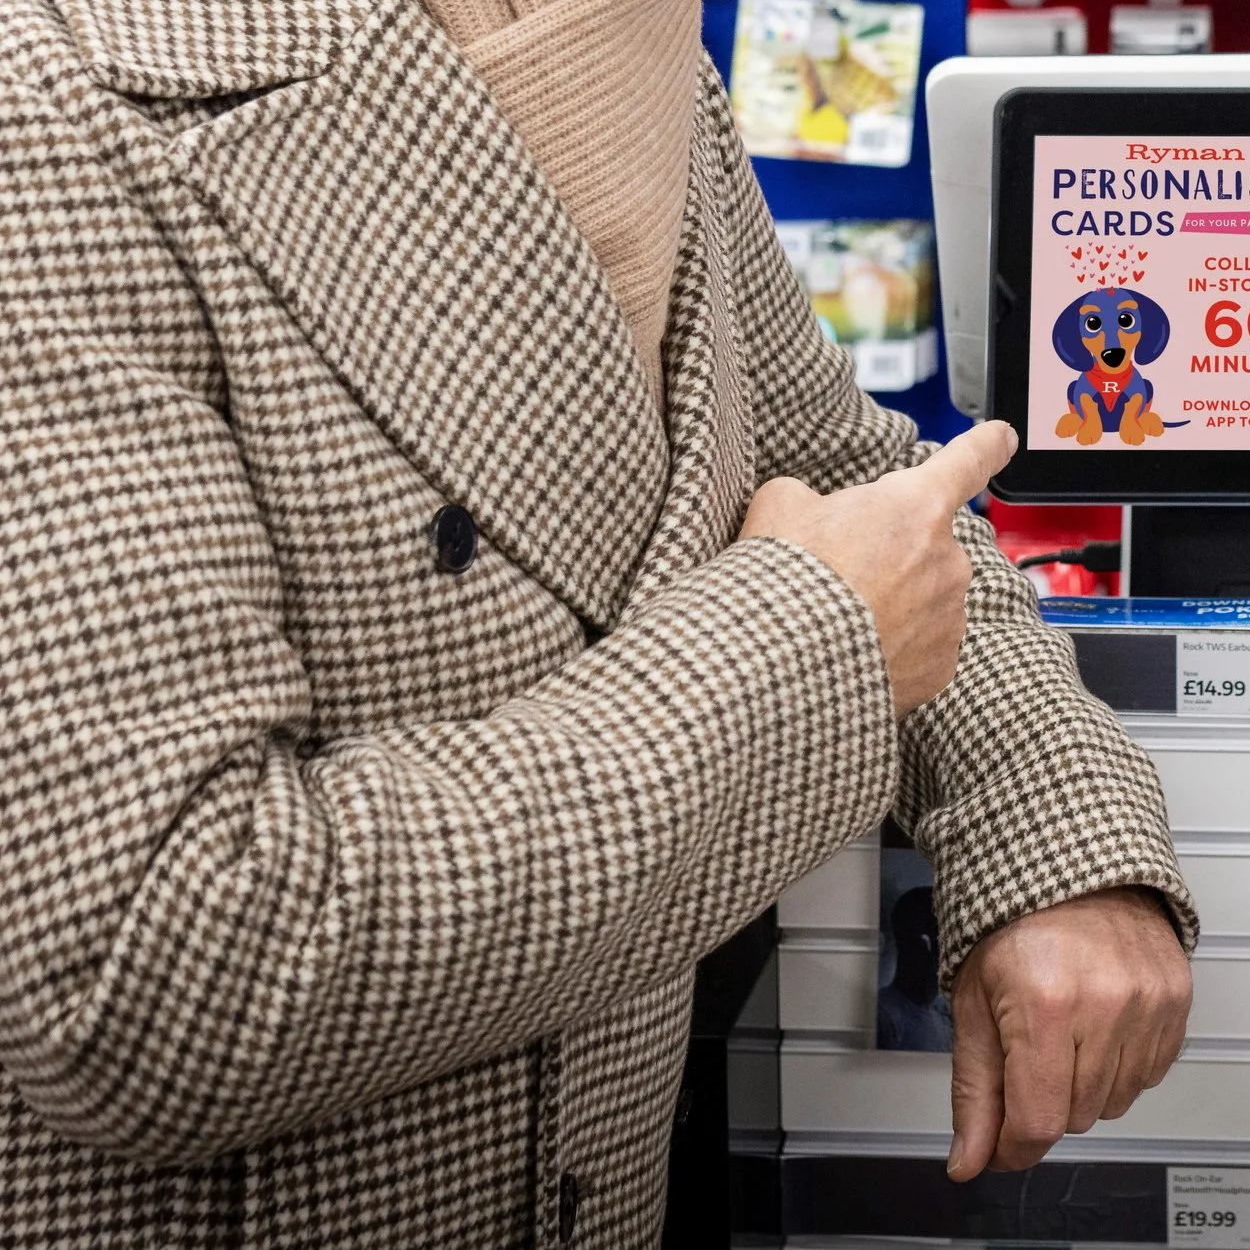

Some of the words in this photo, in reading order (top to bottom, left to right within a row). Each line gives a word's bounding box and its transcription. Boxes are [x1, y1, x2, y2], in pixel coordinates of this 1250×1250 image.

[1126, 144, 1245, 163] Ryman
[1051, 210, 1175, 237] CARDS
[1185, 219, 1206, 228] FOR
[1209, 219, 1237, 228] YOUR
[1101, 381, 1120, 393] R
[1206, 416, 1236, 428] APP
[1183, 642, 1204, 651] Rock
[1206, 643, 1226, 651] TWS
[1183, 680, 1246, 697] £14.99
[1173, 1175, 1193, 1183] Rock
[1194, 1175, 1223, 1183] On-Ear
[1174, 1211, 1237, 1227] £19.99
